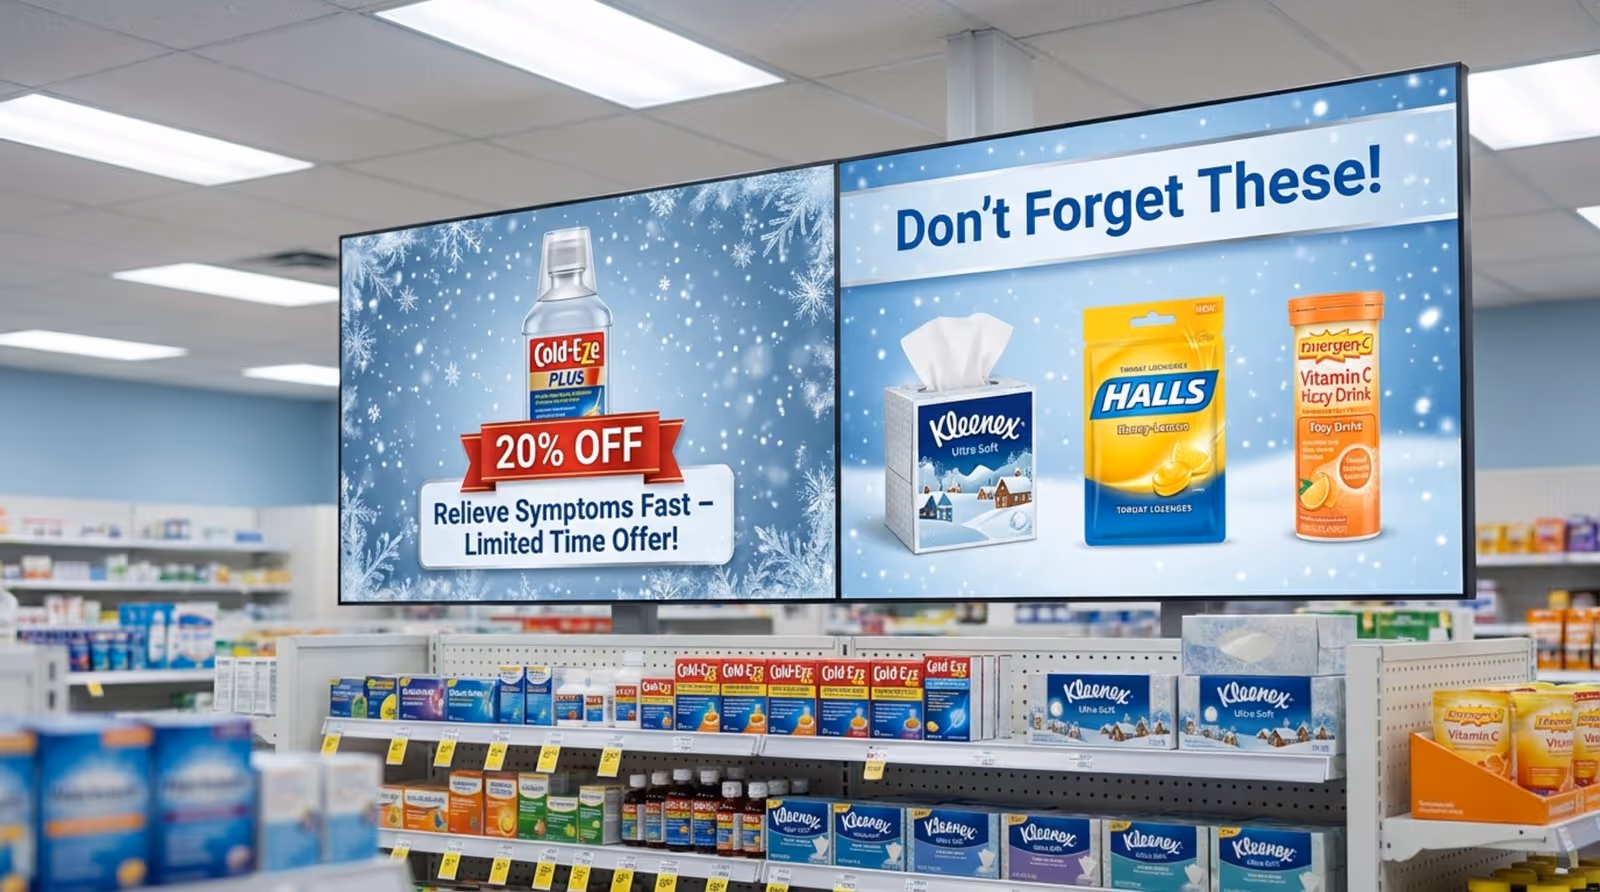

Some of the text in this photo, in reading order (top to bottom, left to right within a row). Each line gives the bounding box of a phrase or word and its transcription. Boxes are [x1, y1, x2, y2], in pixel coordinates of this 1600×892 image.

[897, 144, 1381, 252] Don’t Forget These!
[534, 338, 600, 368] Cold-Eze
[548, 370, 584, 387] PLUS
[1301, 366, 1371, 386] Vitamin C
[1101, 378, 1206, 413] HALLS
[1336, 386, 1371, 402] Drink
[929, 410, 1021, 447] Kleenex
[496, 426, 643, 469] 20% OFF
[978, 442, 998, 454] Soft
[433, 501, 509, 525] Relieve
[515, 497, 634, 528] Symptoms
[641, 492, 690, 517] Fast
[464, 526, 678, 556] Limited Time Offer!
[821, 665, 845, 681] Cold
[874, 665, 897, 681] Cold
[1217, 681, 1291, 709] Kleenex
